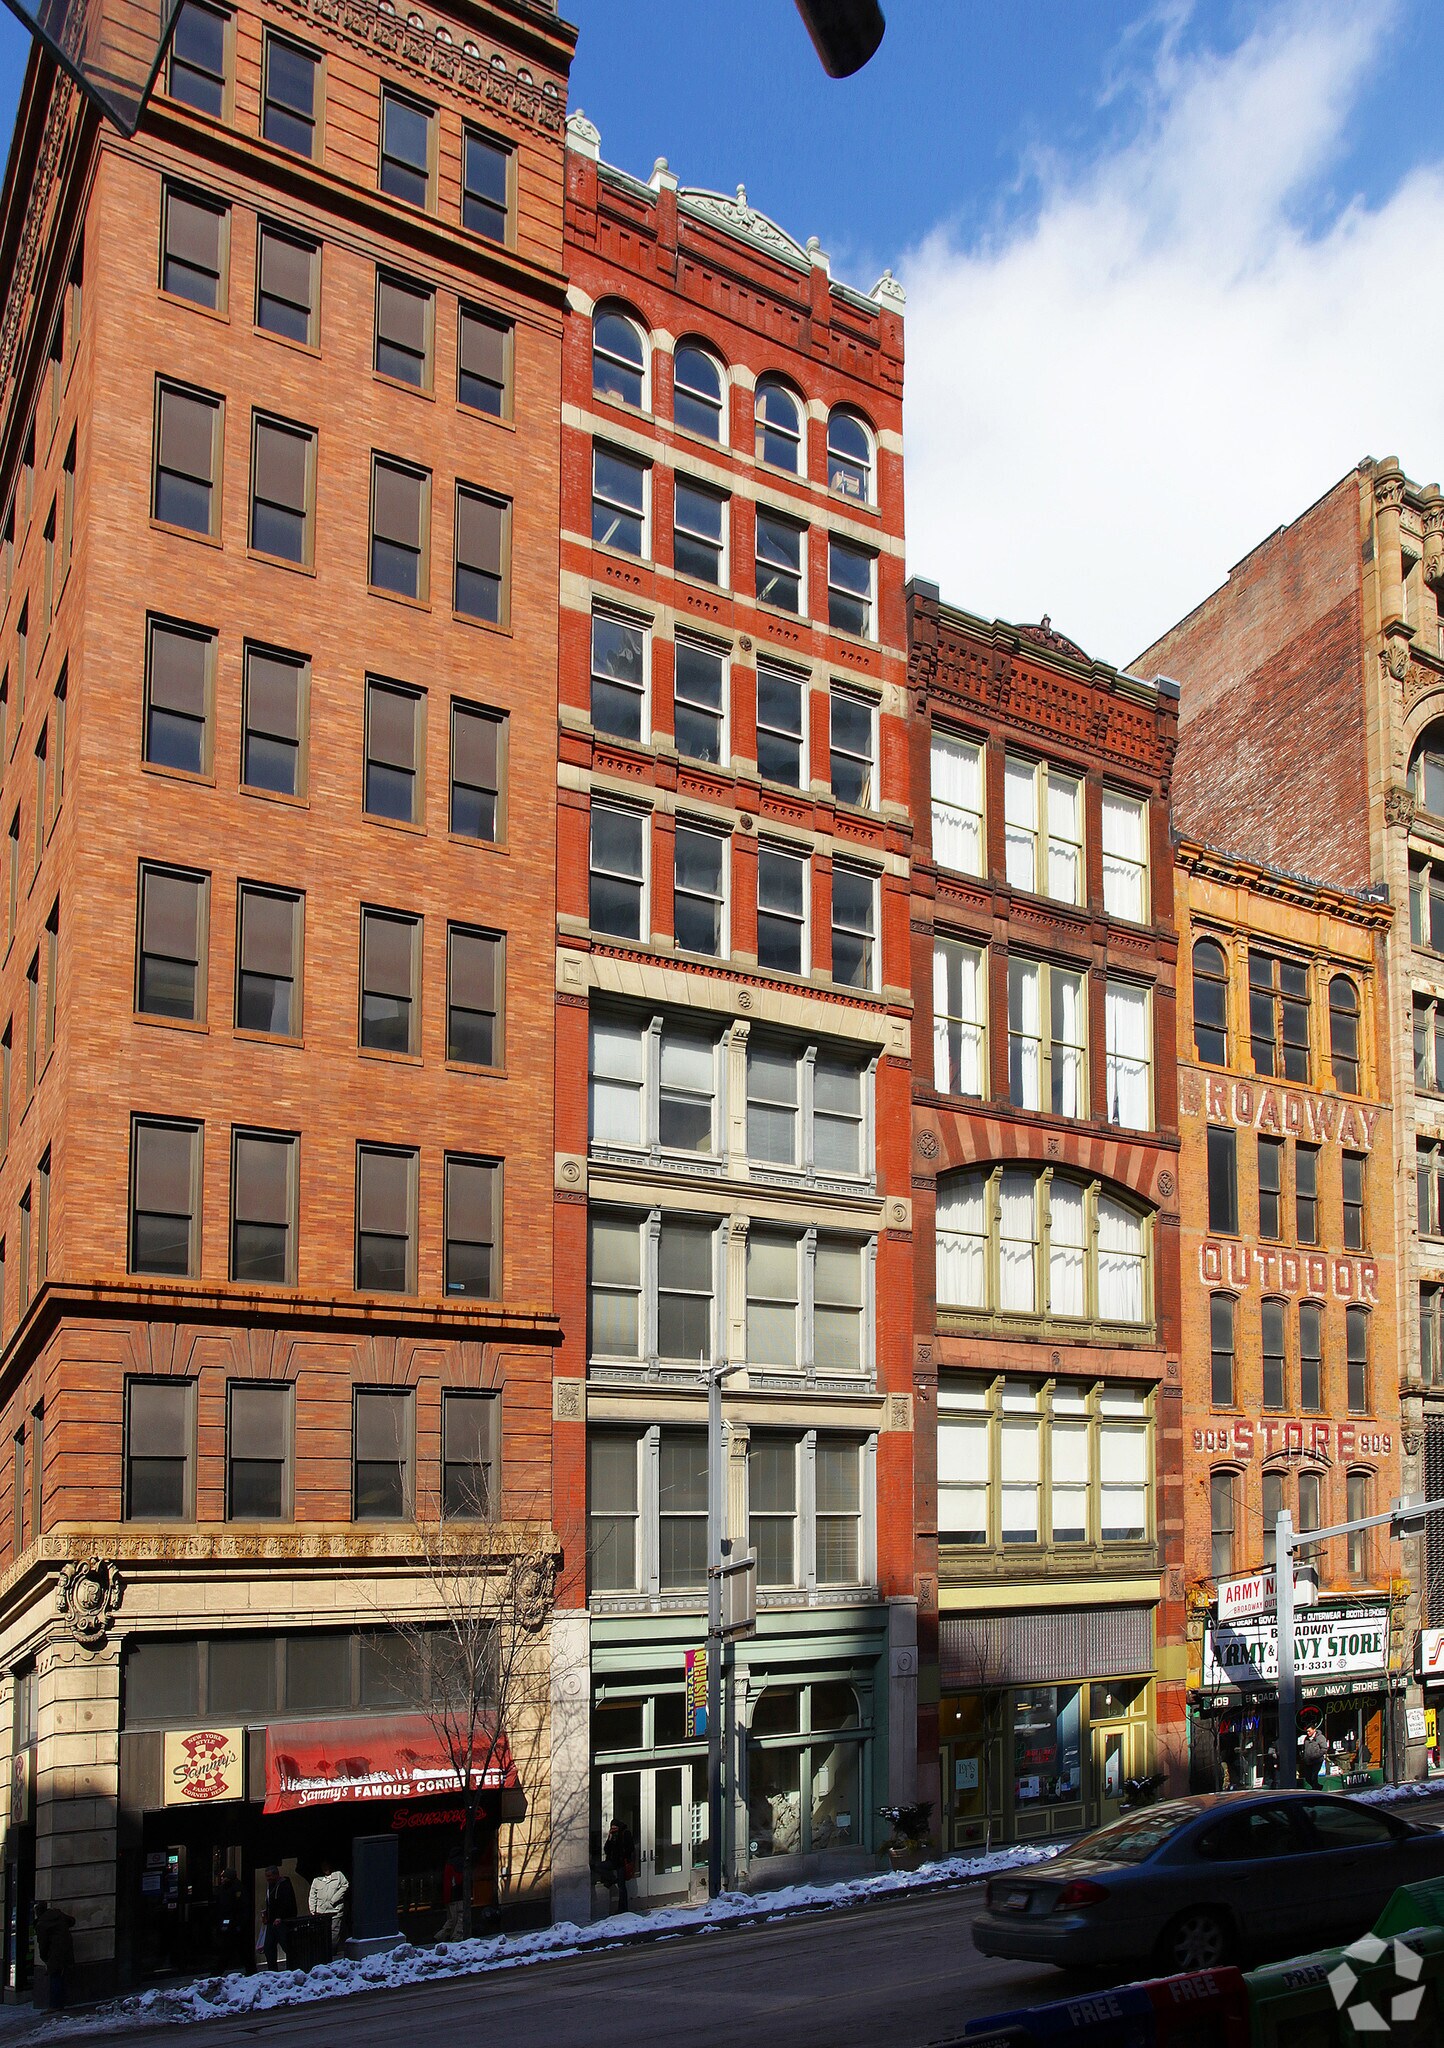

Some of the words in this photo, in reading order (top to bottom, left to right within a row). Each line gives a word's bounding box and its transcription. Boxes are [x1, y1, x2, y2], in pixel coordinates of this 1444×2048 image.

[1180, 1073, 1380, 1149] BROADWAY
[1199, 1242, 1379, 1303] OUTDOOR
[1194, 1428, 1229, 1453] 909
[1232, 1420, 1355, 1464] STORE
[1359, 1432, 1393, 1457] 909
[1226, 1580, 1260, 1603] ARMY
[1265, 1572, 1299, 1595] NY
[1233, 1602, 1263, 1614] BROADWAY
[1308, 1611, 1341, 1621] OUTERWEAR
[1346, 1609, 1363, 1618] BOOTS
[1271, 1624, 1334, 1639] BADWAY
[1210, 1642, 1268, 1667] ARMY
[1269, 1645, 1275, 1656] &
[1327, 1633, 1383, 1657] STORE
[1266, 1661, 1332, 1673] 4191-3331
[1246, 1692, 1279, 1704] BROAD
[1301, 1687, 1318, 1697] RMY
[1324, 1685, 1347, 1695] NAVY
[1352, 1681, 1379, 1691] STORE
[188, 1735, 202, 1744] NEW
[205, 1733, 223, 1741] YORK
[1427, 1721, 1435, 1737] LE
[173, 1750, 238, 1784] Sammy's
[183, 1788, 208, 1798] CORNED
[211, 1785, 226, 1796] BEEF
[299, 1785, 348, 1805] Sammy's
[354, 1785, 411, 1798] FAMOUS
[1168, 1974, 1220, 2003] FREE
[1282, 1964, 1328, 1989] FREE
[1067, 1994, 1123, 2027] FREE
